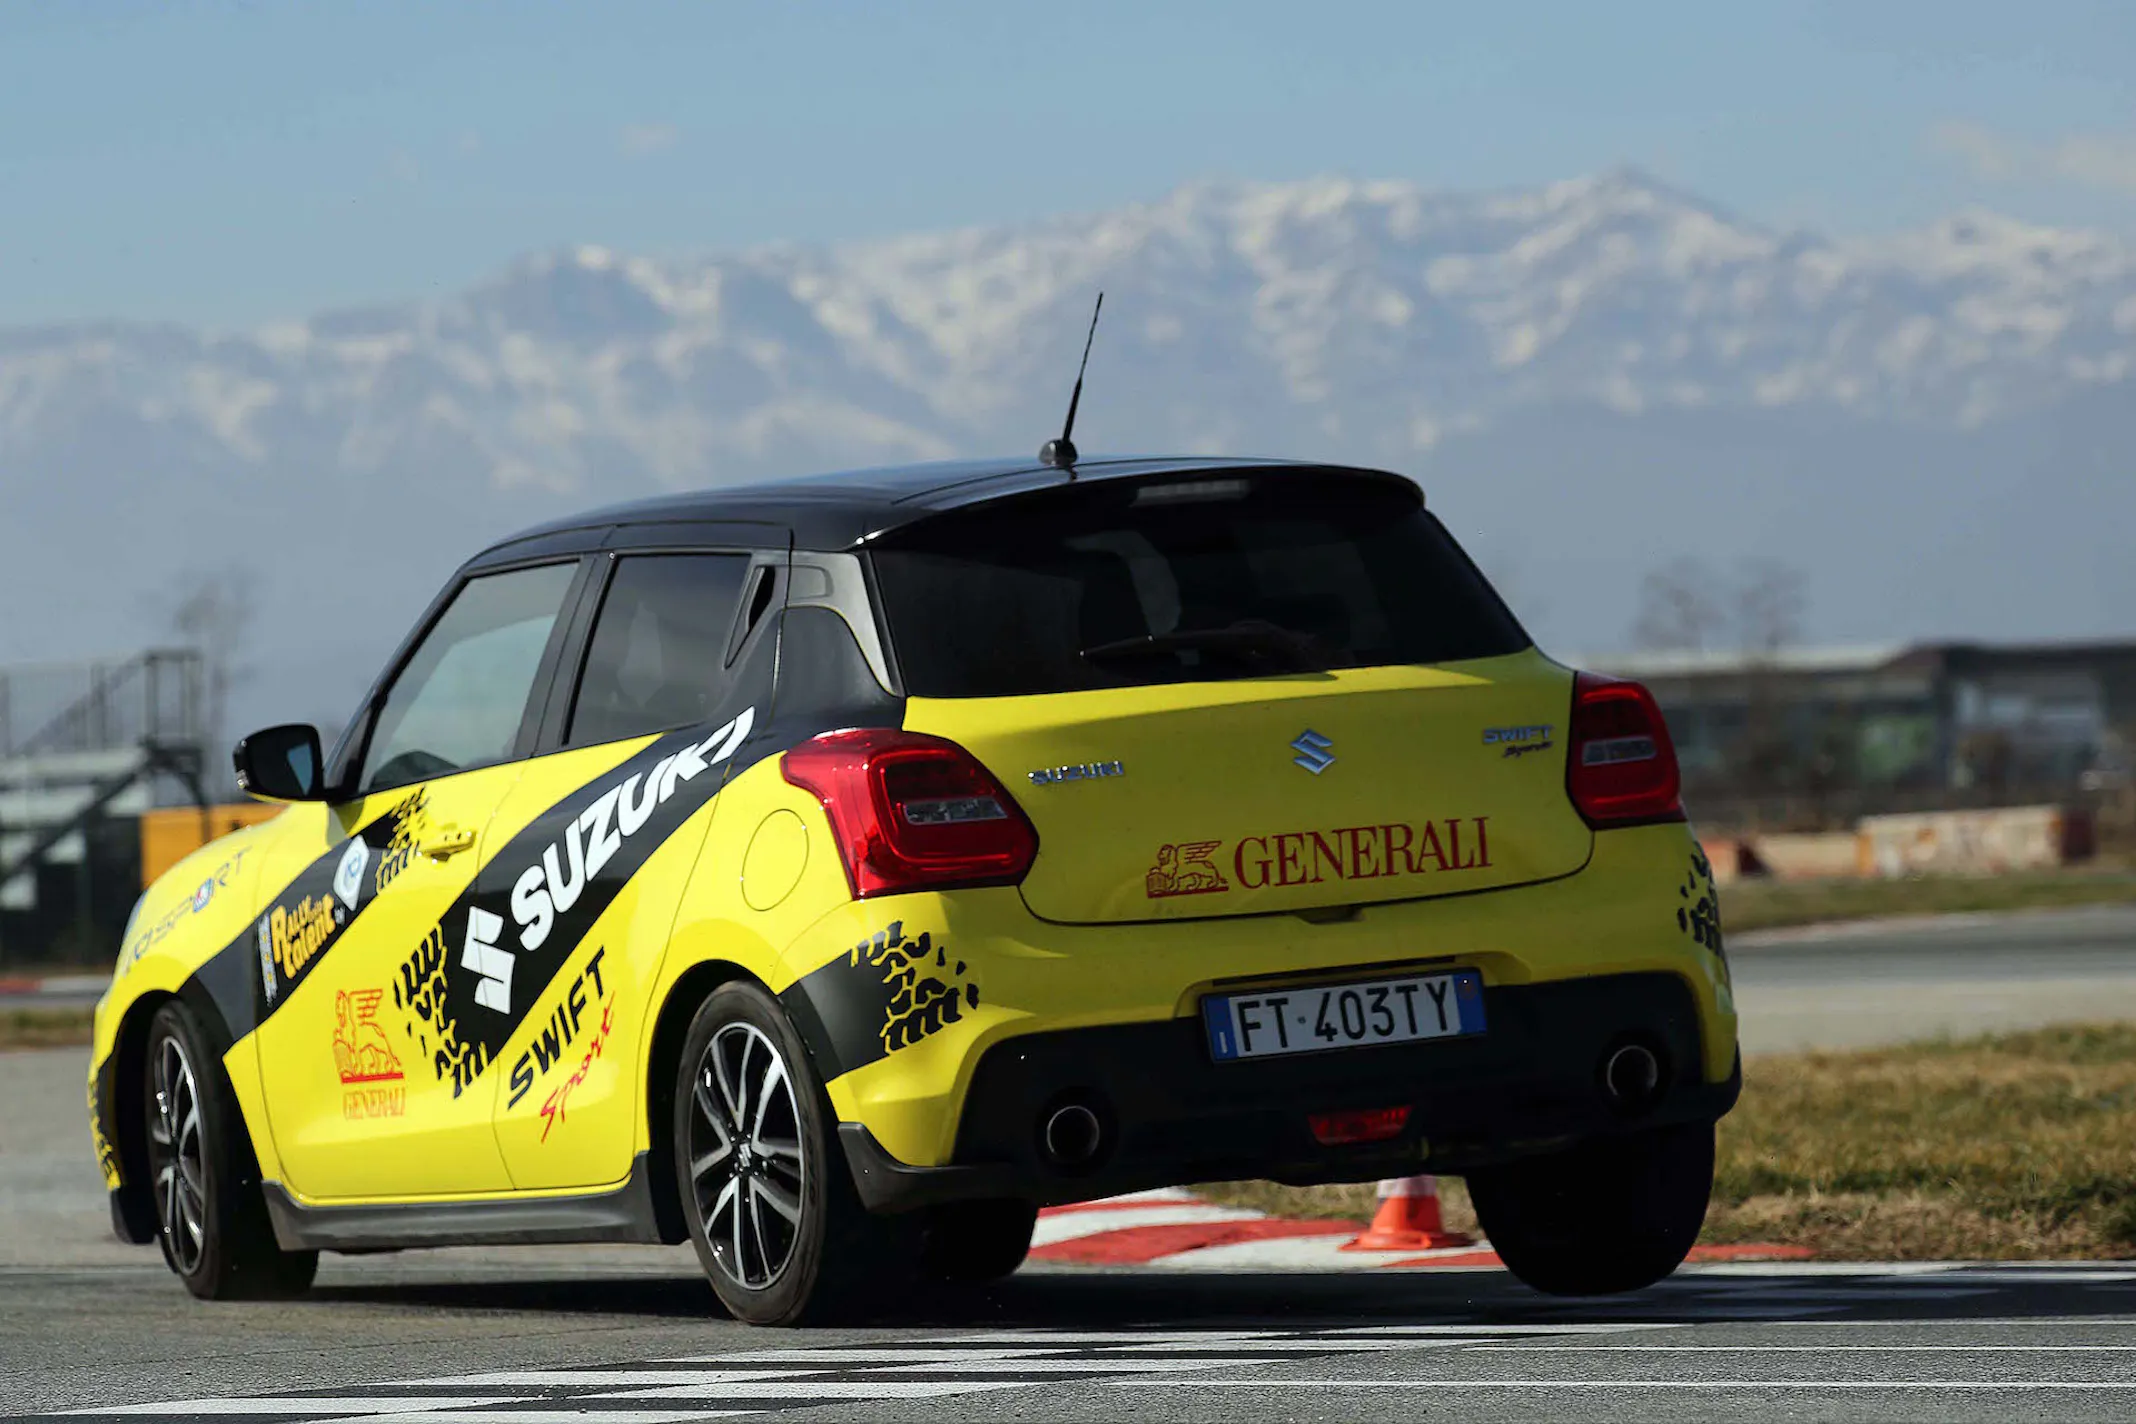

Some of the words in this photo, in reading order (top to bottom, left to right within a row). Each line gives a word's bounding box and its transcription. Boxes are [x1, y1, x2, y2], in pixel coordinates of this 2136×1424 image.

[1482, 724, 1556, 745] SWIFT
[1028, 760, 1124, 786] SUZUKI
[509, 704, 756, 952] SUZUKI
[1233, 816, 1494, 891] GENERALI
[507, 944, 606, 1111] SWIFT
[1236, 997, 1289, 1053] FT
[1314, 980, 1449, 1043] 403TY
[342, 1086, 406, 1121] GENERALI
[539, 989, 616, 1145] Sport
